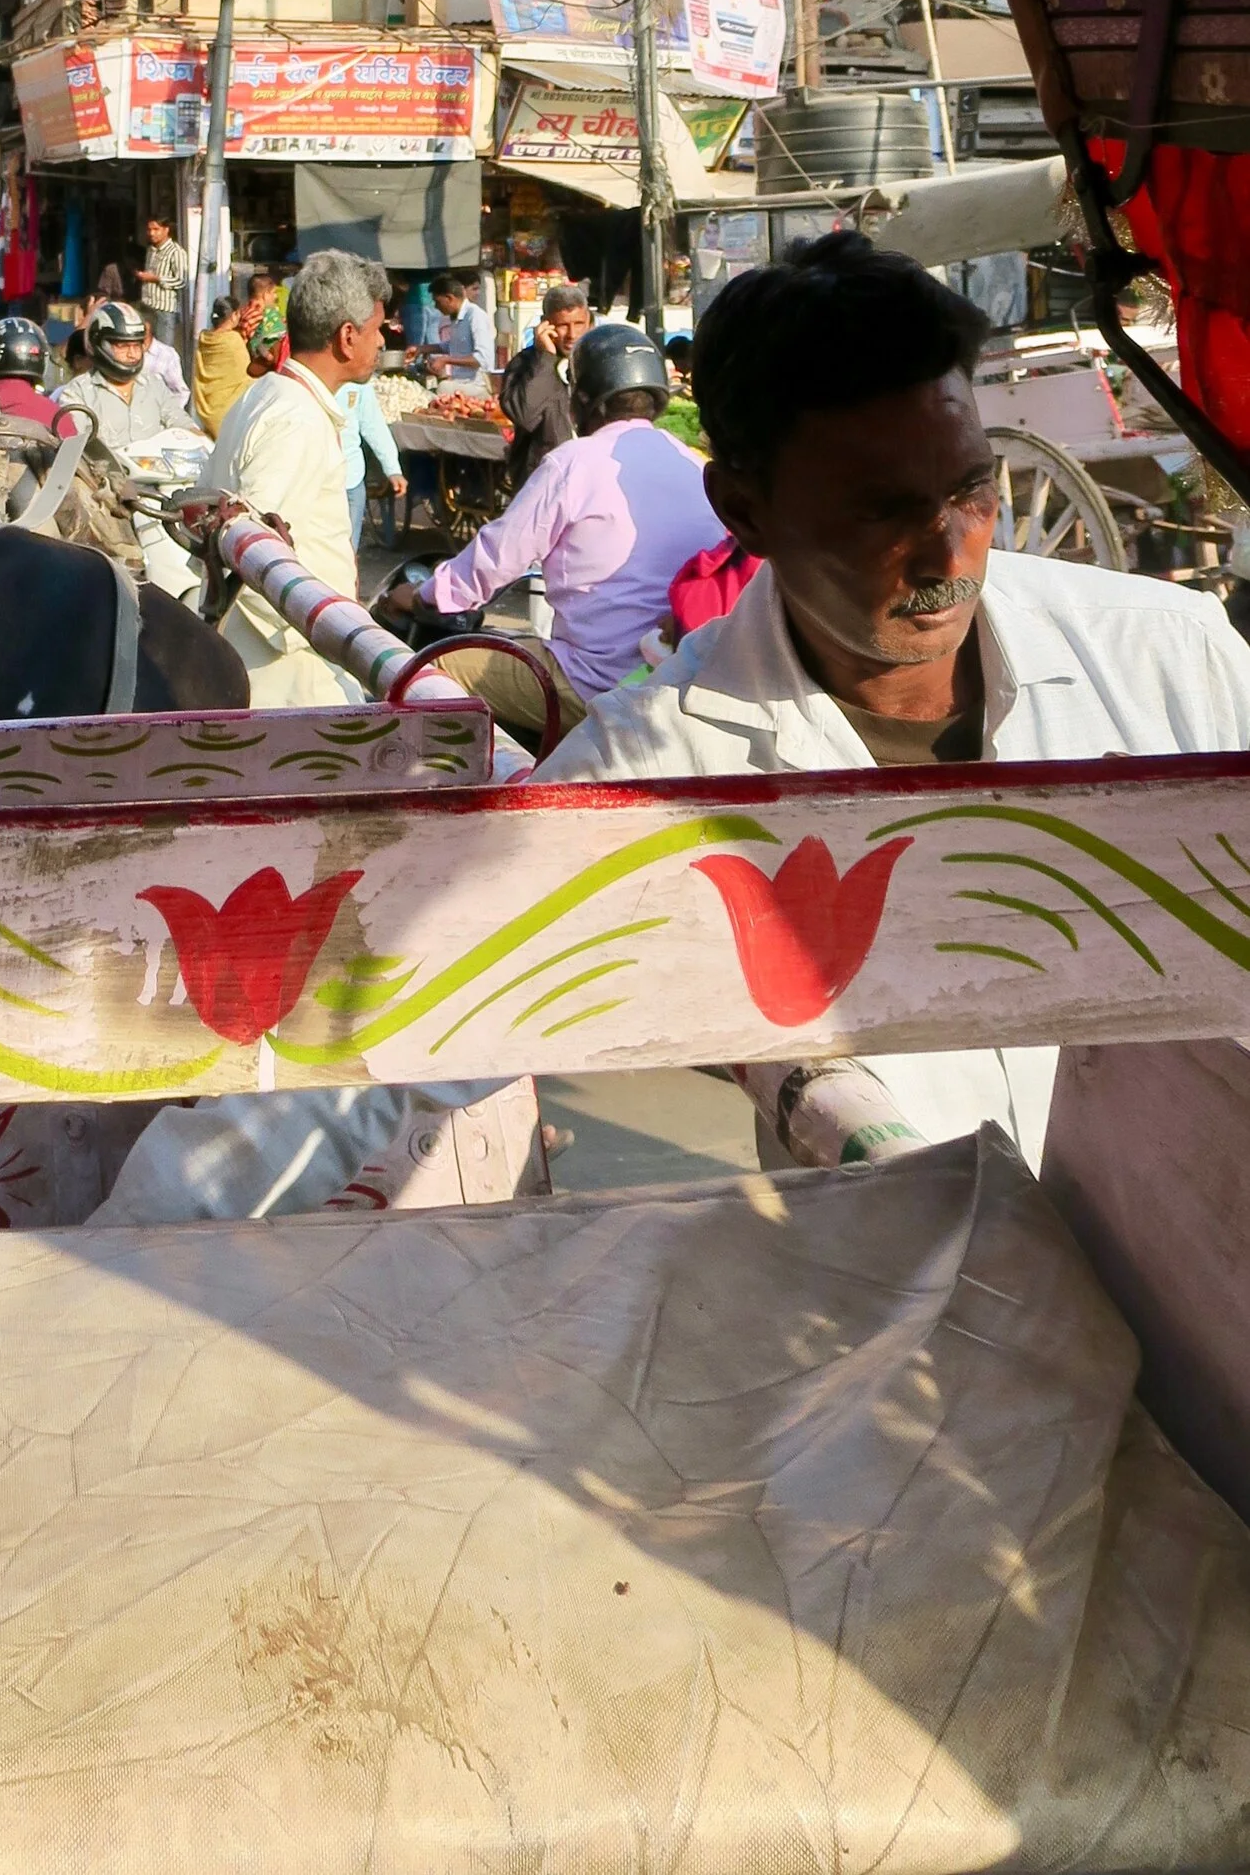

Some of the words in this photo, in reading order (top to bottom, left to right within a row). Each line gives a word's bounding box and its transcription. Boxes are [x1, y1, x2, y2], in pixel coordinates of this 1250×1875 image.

[329, 62, 346, 84] &
[354, 55, 410, 84] सर्विस
[415, 56, 470, 87] सेन्टर
